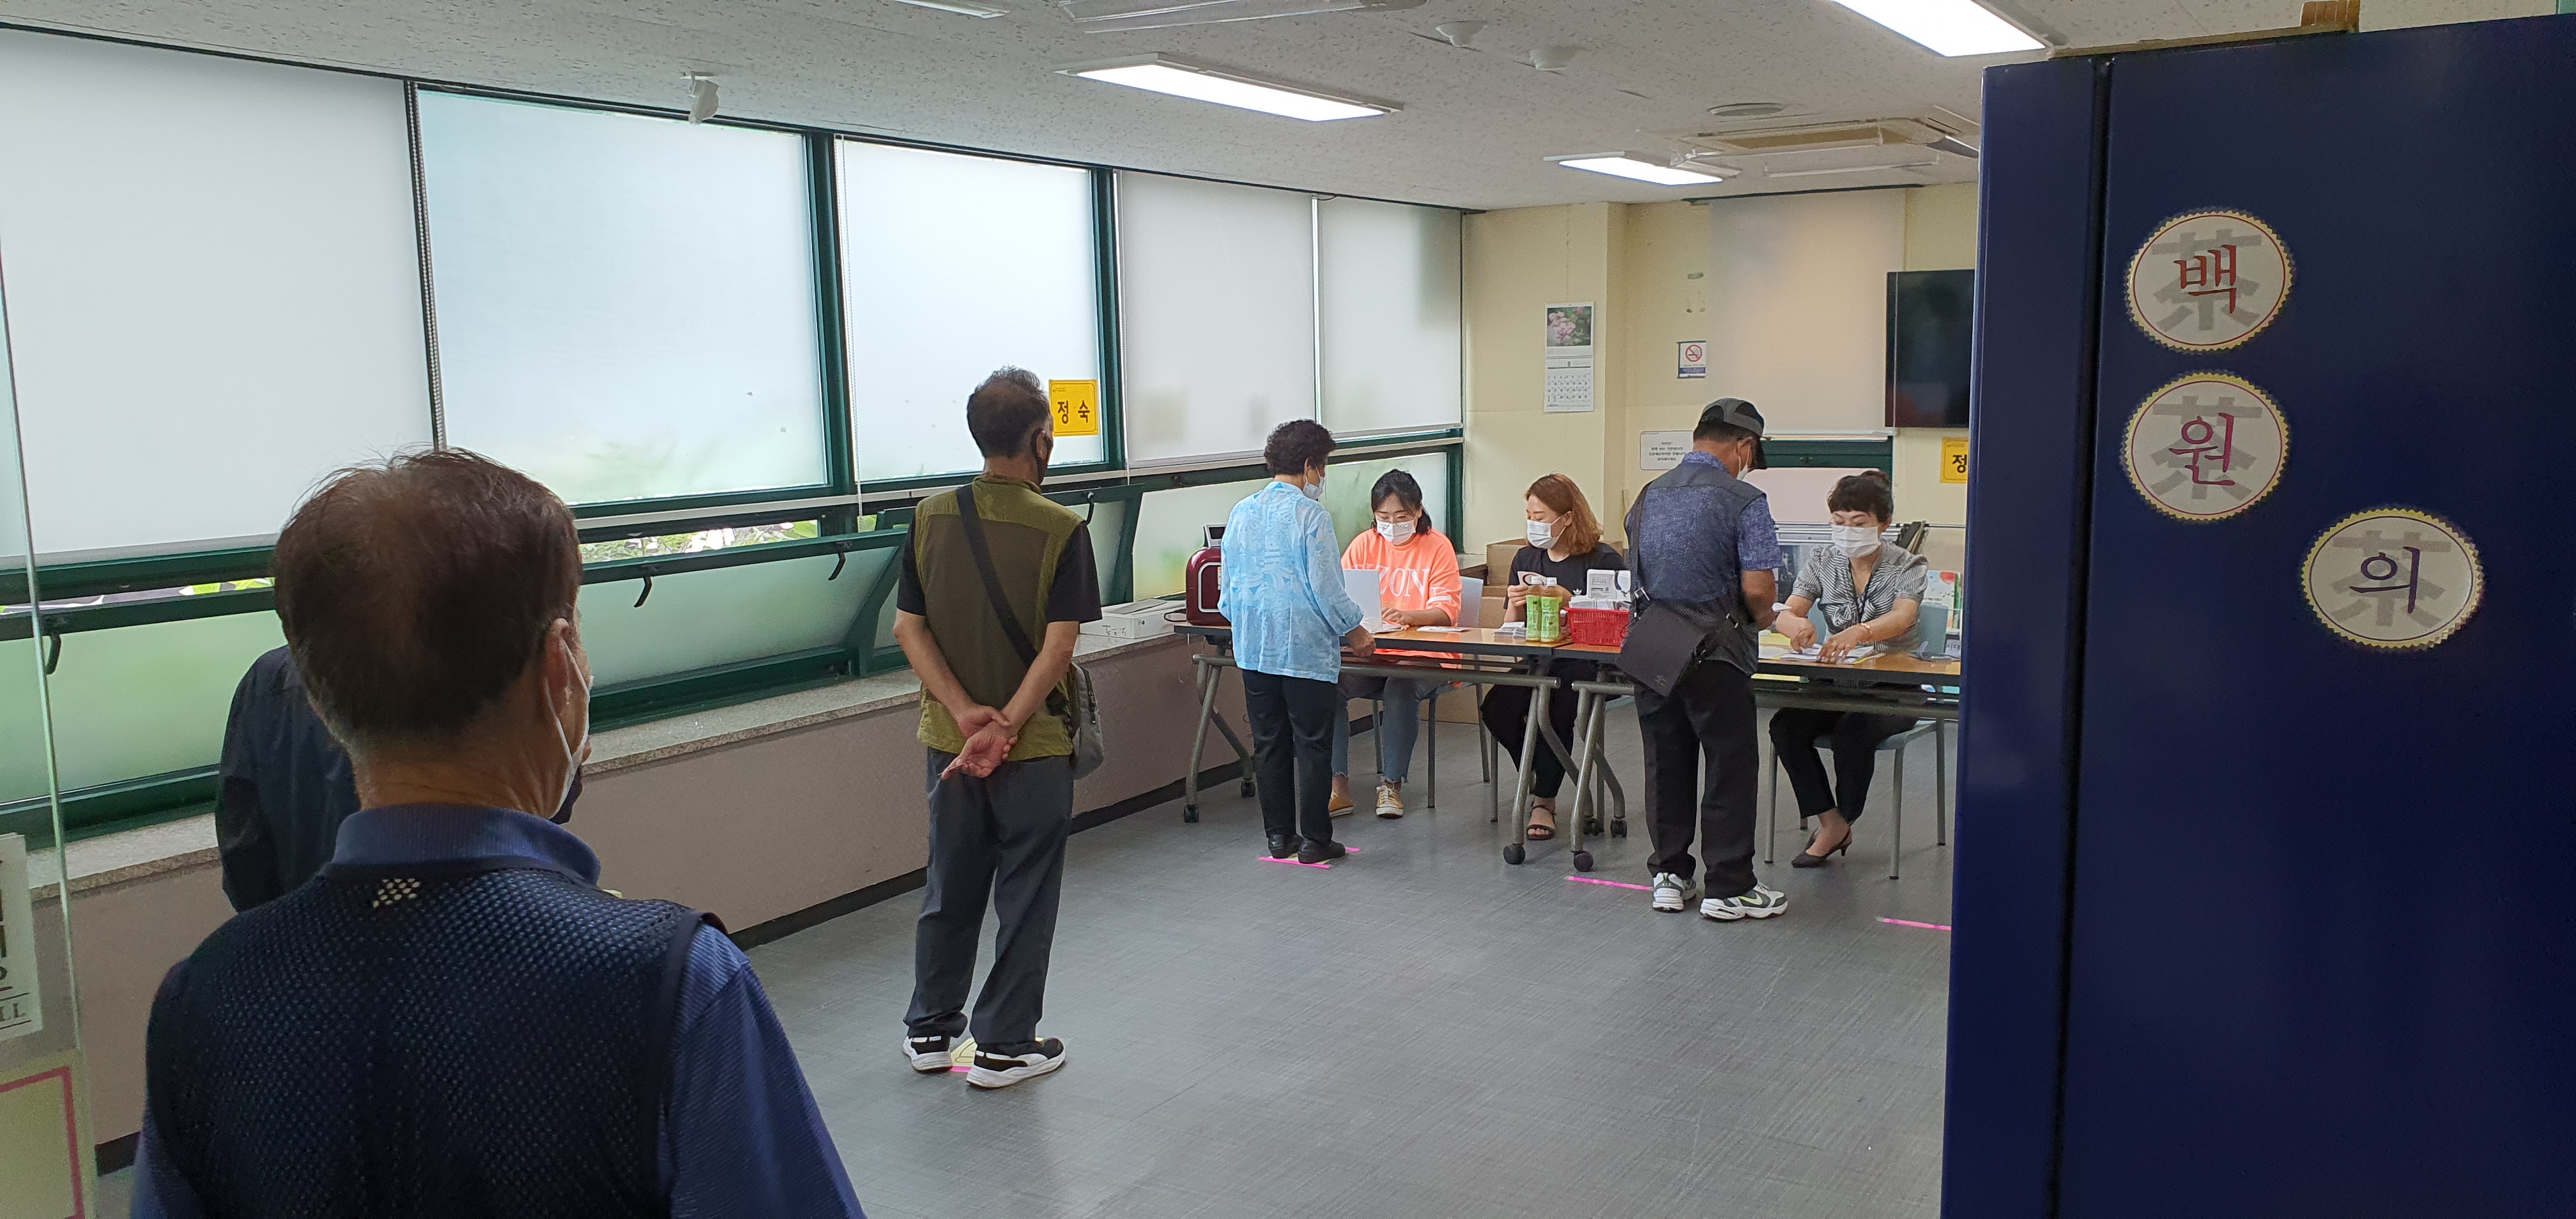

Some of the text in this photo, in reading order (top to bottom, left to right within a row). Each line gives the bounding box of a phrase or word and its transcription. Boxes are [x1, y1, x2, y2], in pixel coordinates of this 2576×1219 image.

[2174, 244, 2237, 313] 백
[1952, 454, 1967, 473] 정
[2168, 412, 2235, 486] 원
[2350, 546, 2420, 613] 의
